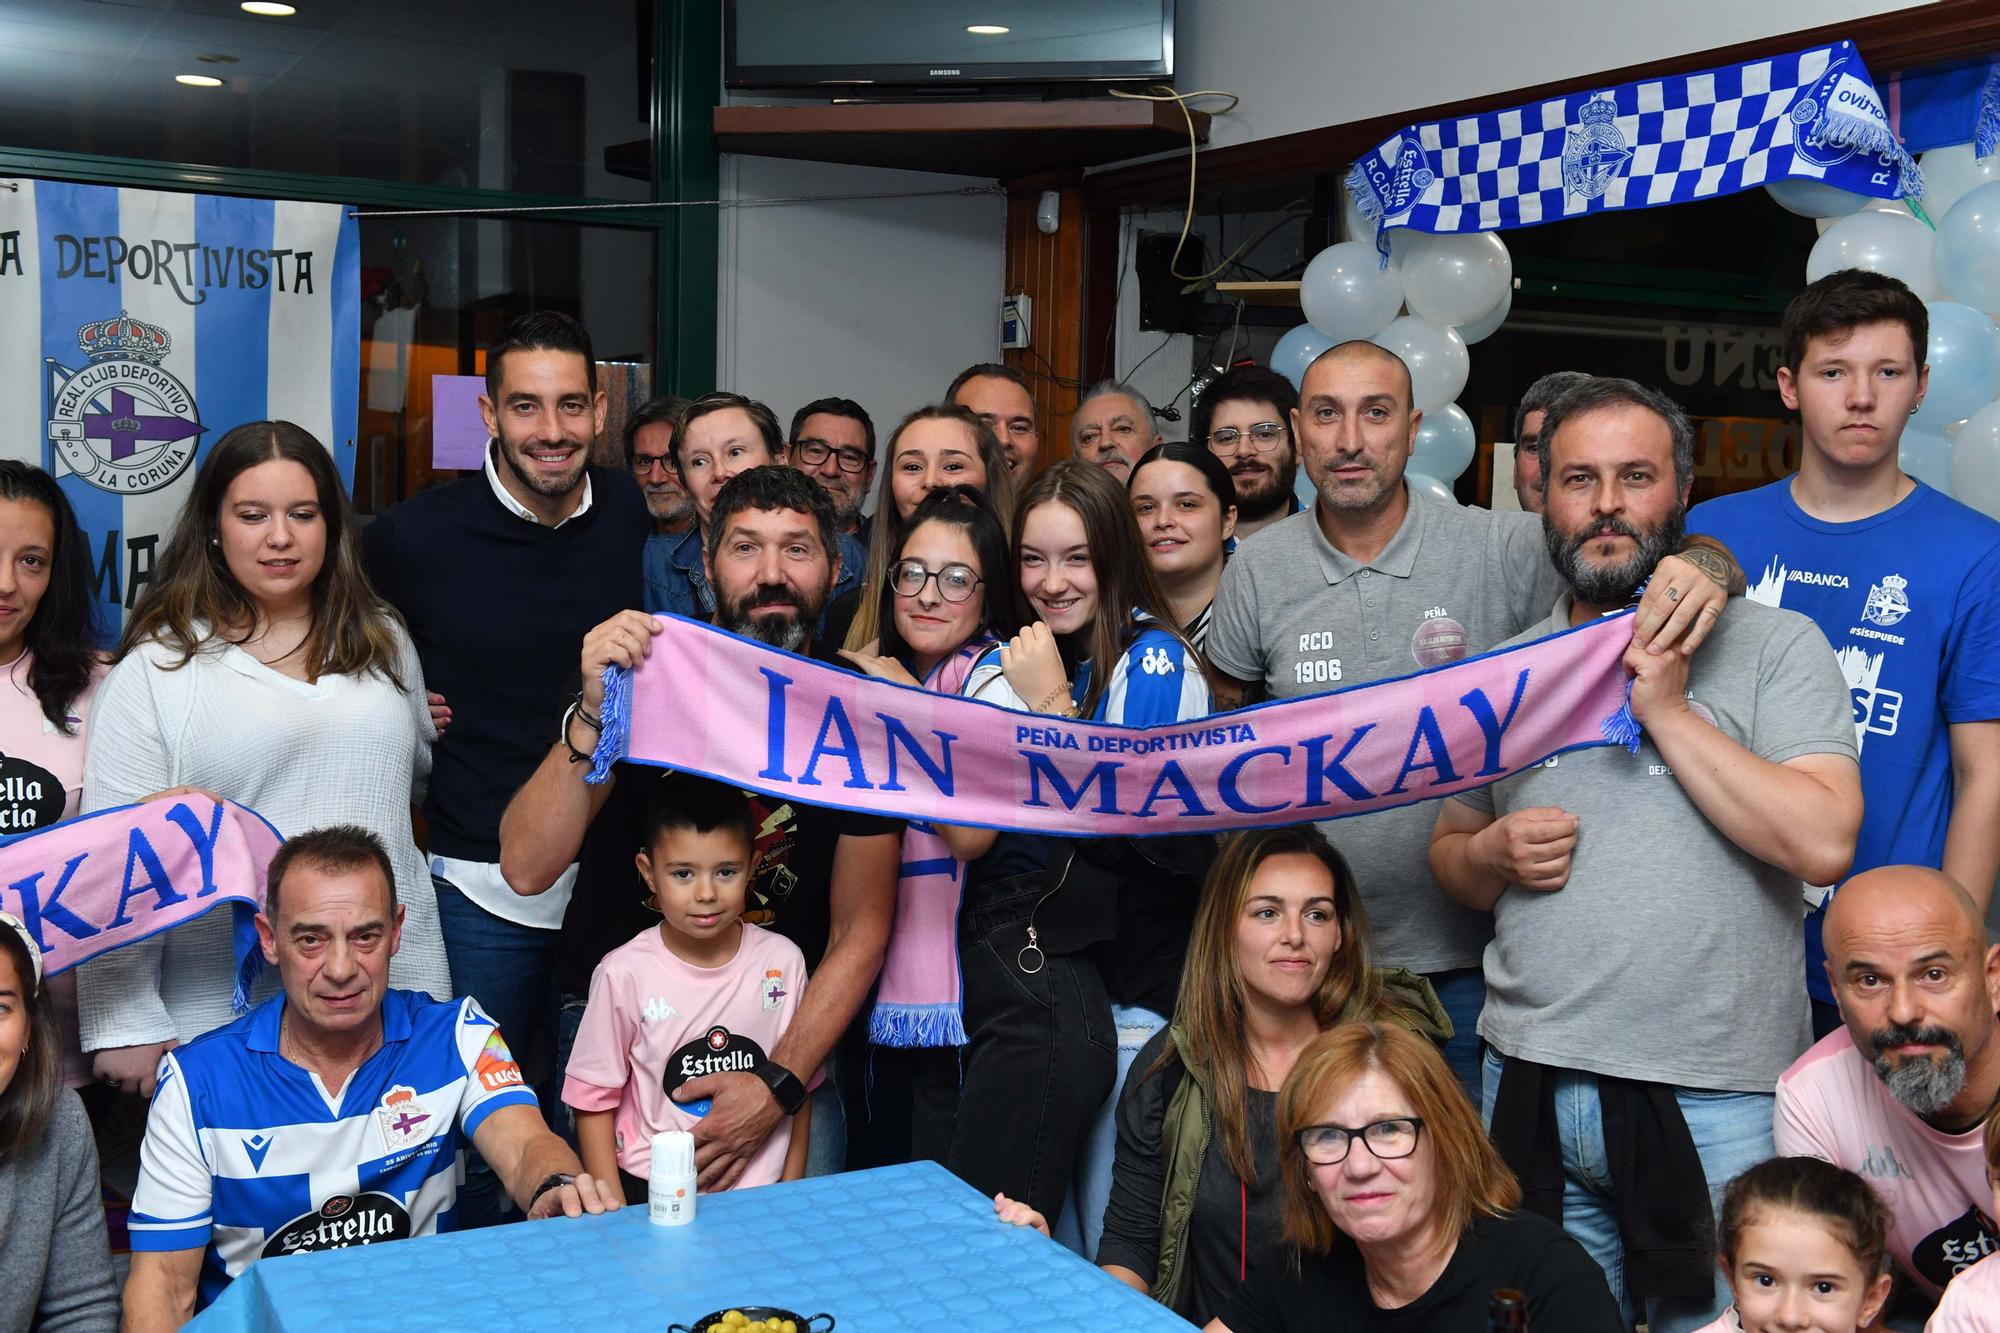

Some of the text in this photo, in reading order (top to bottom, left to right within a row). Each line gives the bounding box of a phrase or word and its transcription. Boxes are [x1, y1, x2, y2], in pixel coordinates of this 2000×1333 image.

[929, 69, 961, 77] SAMSUNG
[1395, 149, 1418, 207] Estrella
[54, 233, 314, 305] DEPORTIVISTA
[59, 364, 189, 417] REAL CLUB DEPORTIVO
[98, 449, 187, 488] LA CORUÑA
[1424, 606, 1448, 619] PEÑA
[1298, 631, 1333, 653] RCD
[1849, 626, 1906, 646] #SÍSEPUEDE
[1294, 658, 1342, 684] 1906
[758, 666, 1531, 818] IAN MACKAY
[1016, 723, 1257, 755] PEÑA DEPORTIVISTA
[0, 803, 225, 954] KAY
[680, 1050, 755, 1076] Estrella
[281, 1209, 396, 1252] Estrella
